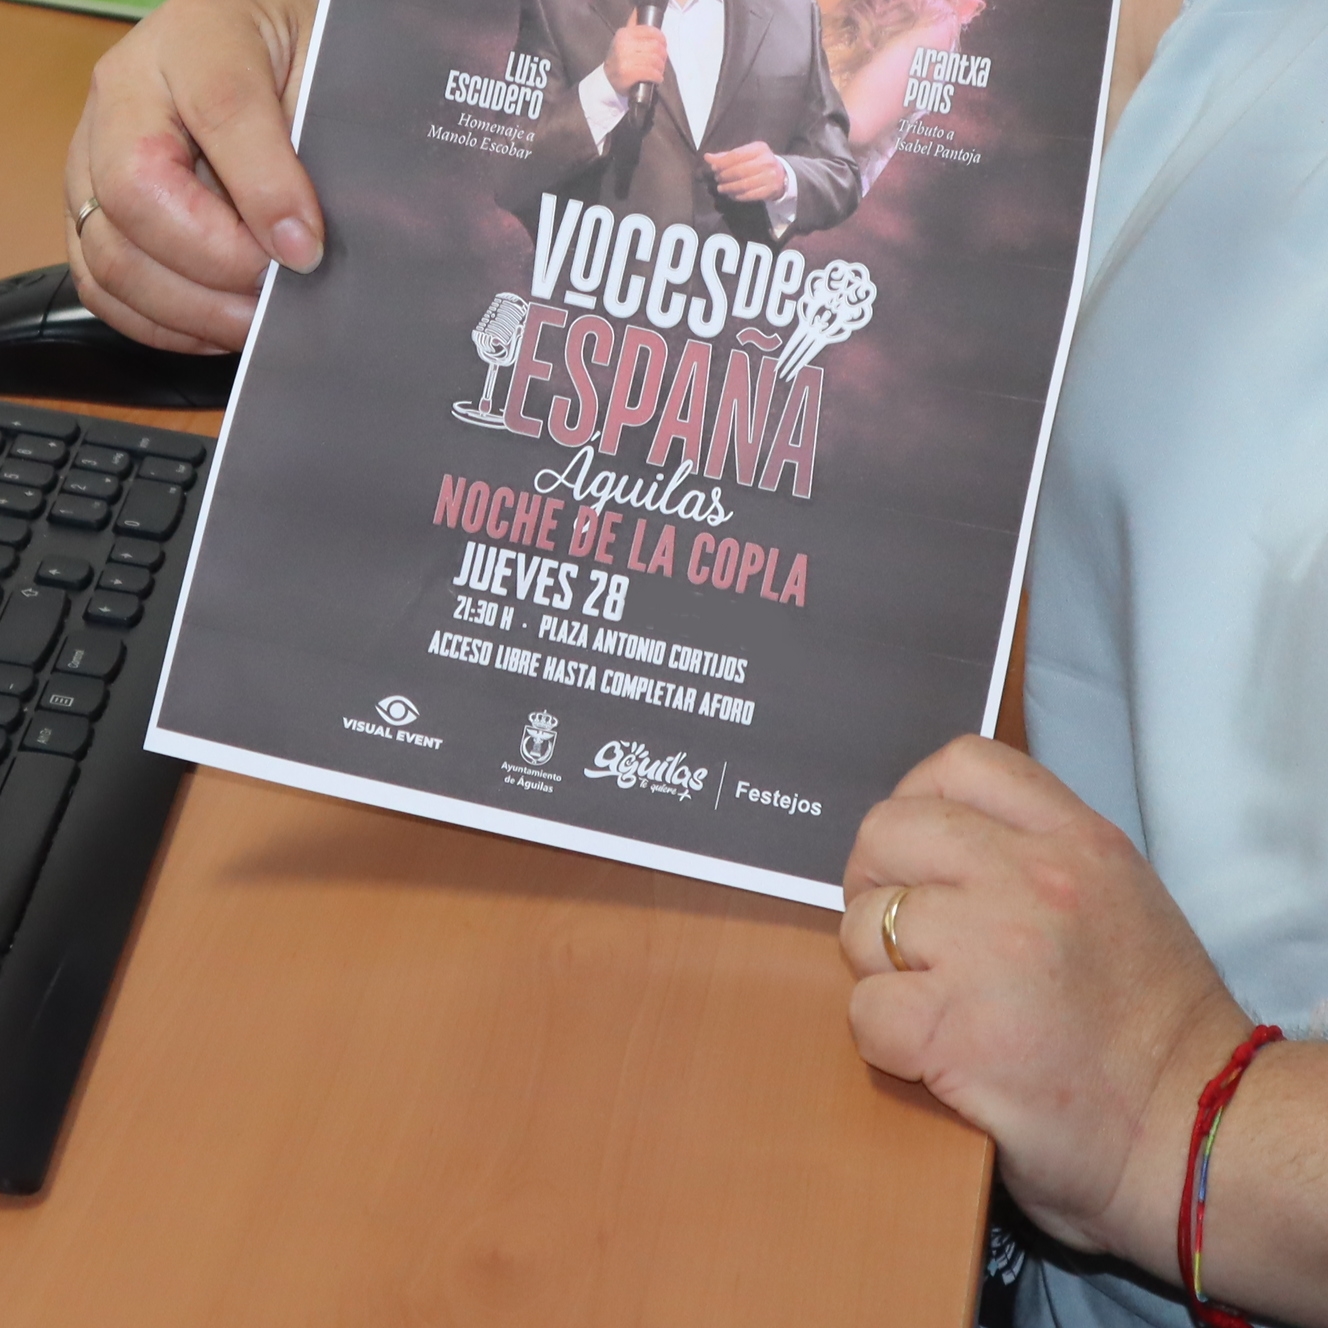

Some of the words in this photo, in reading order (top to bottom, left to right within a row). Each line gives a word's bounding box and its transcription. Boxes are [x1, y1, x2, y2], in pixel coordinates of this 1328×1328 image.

[427, 124, 477, 147] Manolo
[480, 137, 532, 160] Escobar
[458, 112, 524, 140] Homenaje
[526, 131, 536, 142] a
[898, 118, 944, 139] Tributo
[946, 129, 955, 141] a
[894, 137, 933, 156] Isabel
[934, 143, 982, 166] Pantoja
[503, 301, 824, 499] ESPAÑA
[534, 430, 734, 534] Águilas
[432, 473, 565, 552] NOCHE
[568, 505, 623, 565] DE
[627, 518, 676, 578] LA
[686, 532, 808, 608] COPLA
[452, 540, 579, 611] JUEVES
[581, 568, 630, 623] 28
[453, 594, 499, 628] 21:30
[499, 606, 515, 631] H
[537, 614, 589, 649] PLAZA
[592, 627, 667, 666] ANTONIO
[668, 644, 748, 685] CORTIJOS
[427, 630, 493, 666] ACCESO
[494, 644, 542, 677] LIBRE
[543, 657, 598, 691] HASTA
[600, 668, 698, 713] COMPLETAR
[698, 691, 756, 726] AFORO
[342, 716, 393, 740] VISUAL
[396, 730, 443, 750] EVENT
[501, 760, 562, 782] Ayuntamiento
[504, 775, 516, 785] de
[516, 774, 554, 794] Águilas
[735, 780, 823, 816] Festejos
